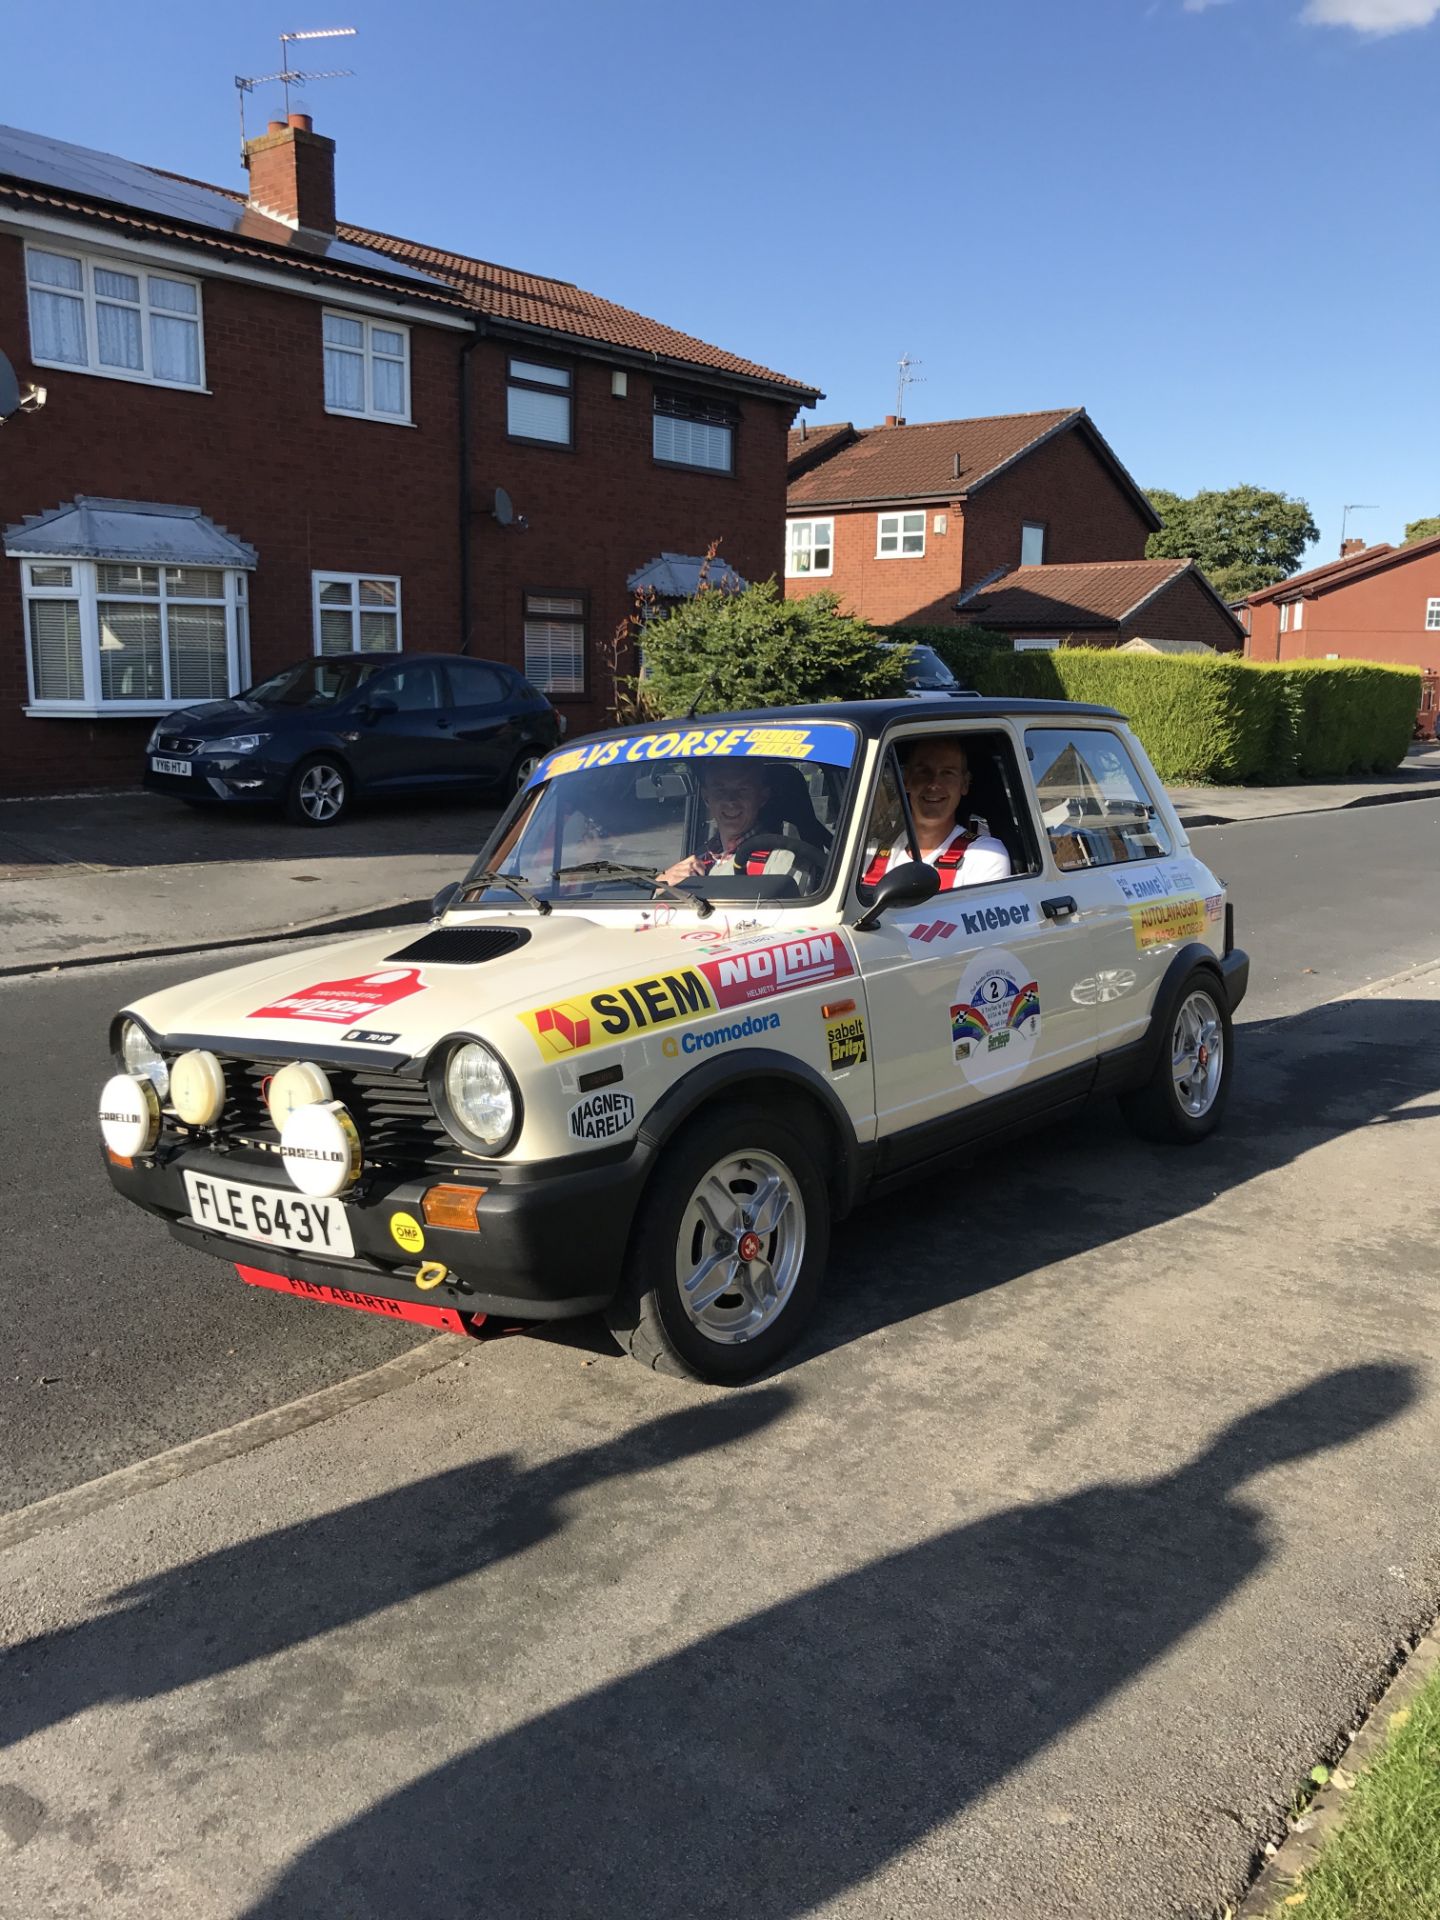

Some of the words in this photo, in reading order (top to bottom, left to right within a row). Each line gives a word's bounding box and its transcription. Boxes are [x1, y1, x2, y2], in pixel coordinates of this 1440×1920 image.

[626, 729, 751, 761] CORSE
[749, 730, 806, 742] OLIO
[751, 745, 811, 756] FIAT
[171, 761, 187, 774] HTJ
[718, 937, 836, 985] NOLAN
[746, 985, 776, 998] HELMETS
[990, 981, 999, 999] 2
[590, 970, 711, 1035] SIEM
[681, 1012, 781, 1054] Cromodora
[827, 1018, 864, 1042] sabelt
[830, 1039, 866, 1065] Britax
[280, 1146, 344, 1163] CARELLO
[396, 1227, 418, 1239] OMP
[288, 1278, 324, 1297] FIAT
[330, 1287, 402, 1315] ABARTH
